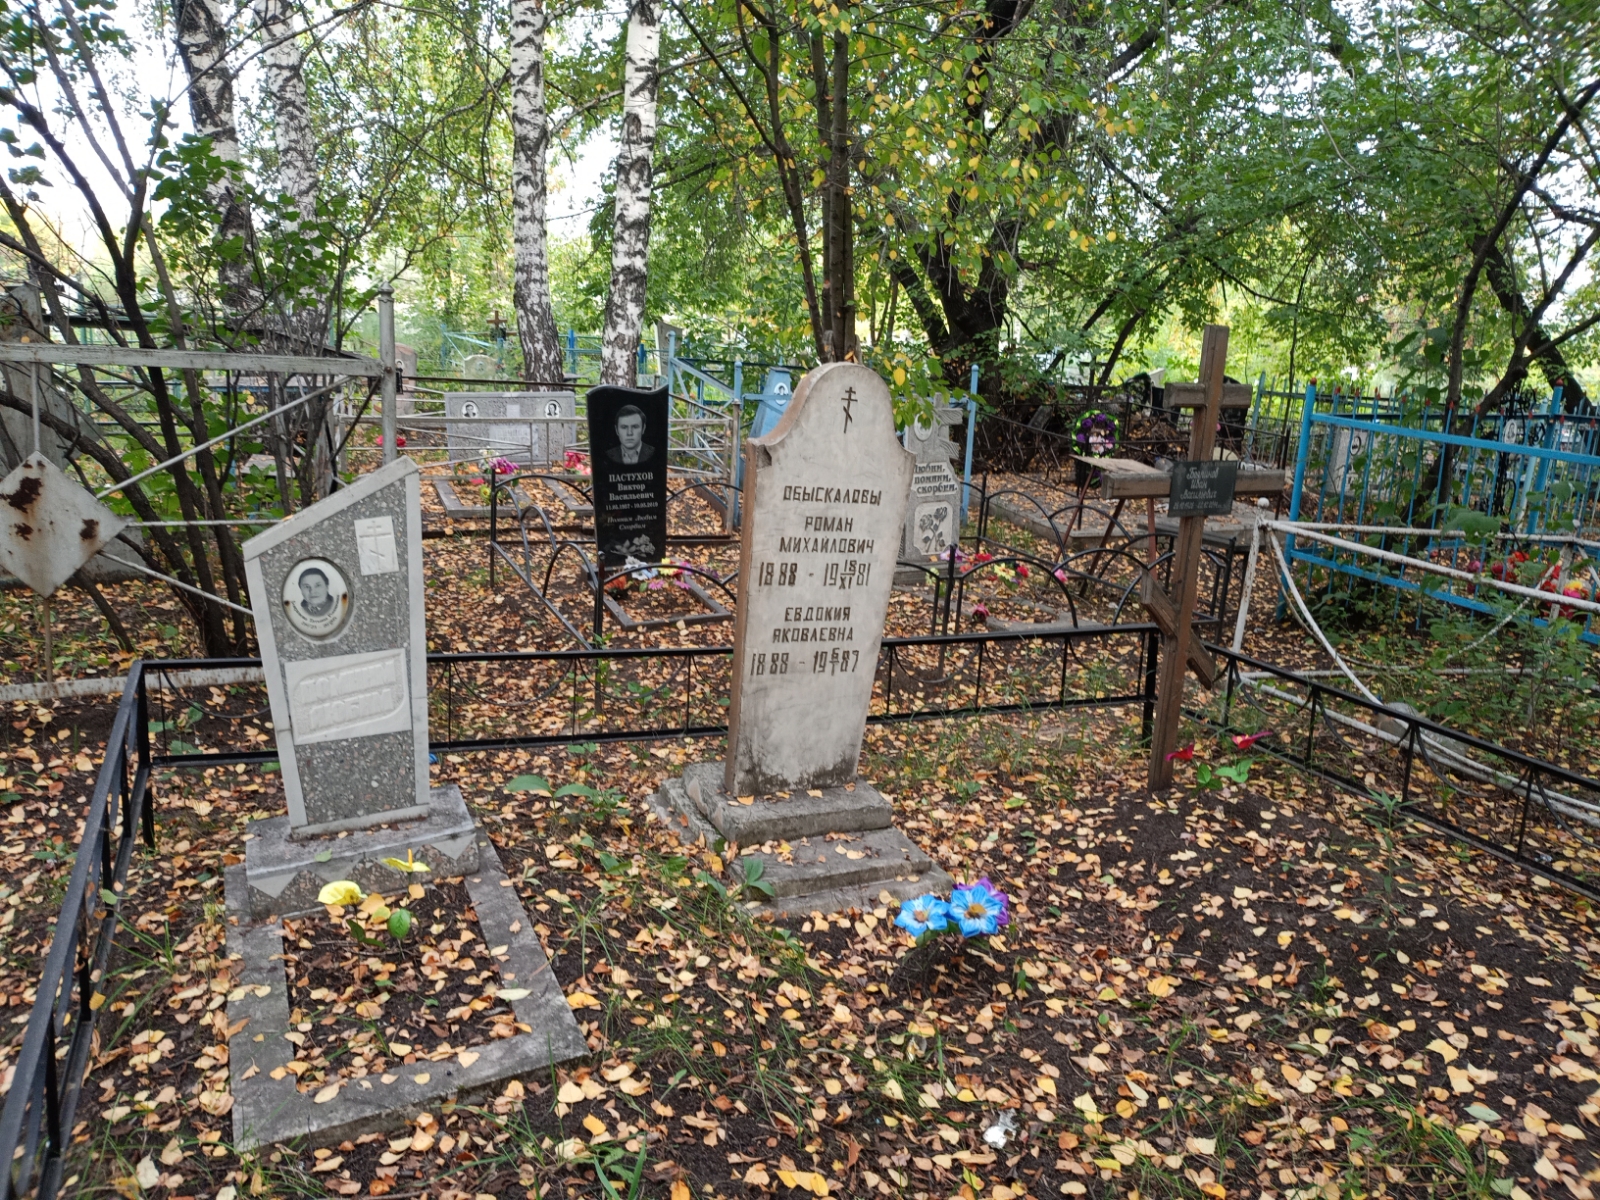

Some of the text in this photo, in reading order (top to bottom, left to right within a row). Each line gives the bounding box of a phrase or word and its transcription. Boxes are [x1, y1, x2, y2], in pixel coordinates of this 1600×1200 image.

[609, 472, 653, 482] ПАСТУХОВ
[618, 483, 646, 491] Виктор
[783, 485, 882, 505] ОБЫСКАЛОВЫ
[608, 492, 654, 501] Васильевич
[804, 516, 854, 532] РОМАН
[779, 536, 875, 554] МИХАЙЛОВИЧ
[758, 562, 798, 587] 1888
[784, 606, 851, 622] ЕВДОКИЯ
[772, 626, 853, 643] ЯКОВЛЕВНА
[750, 652, 789, 676] 1888
